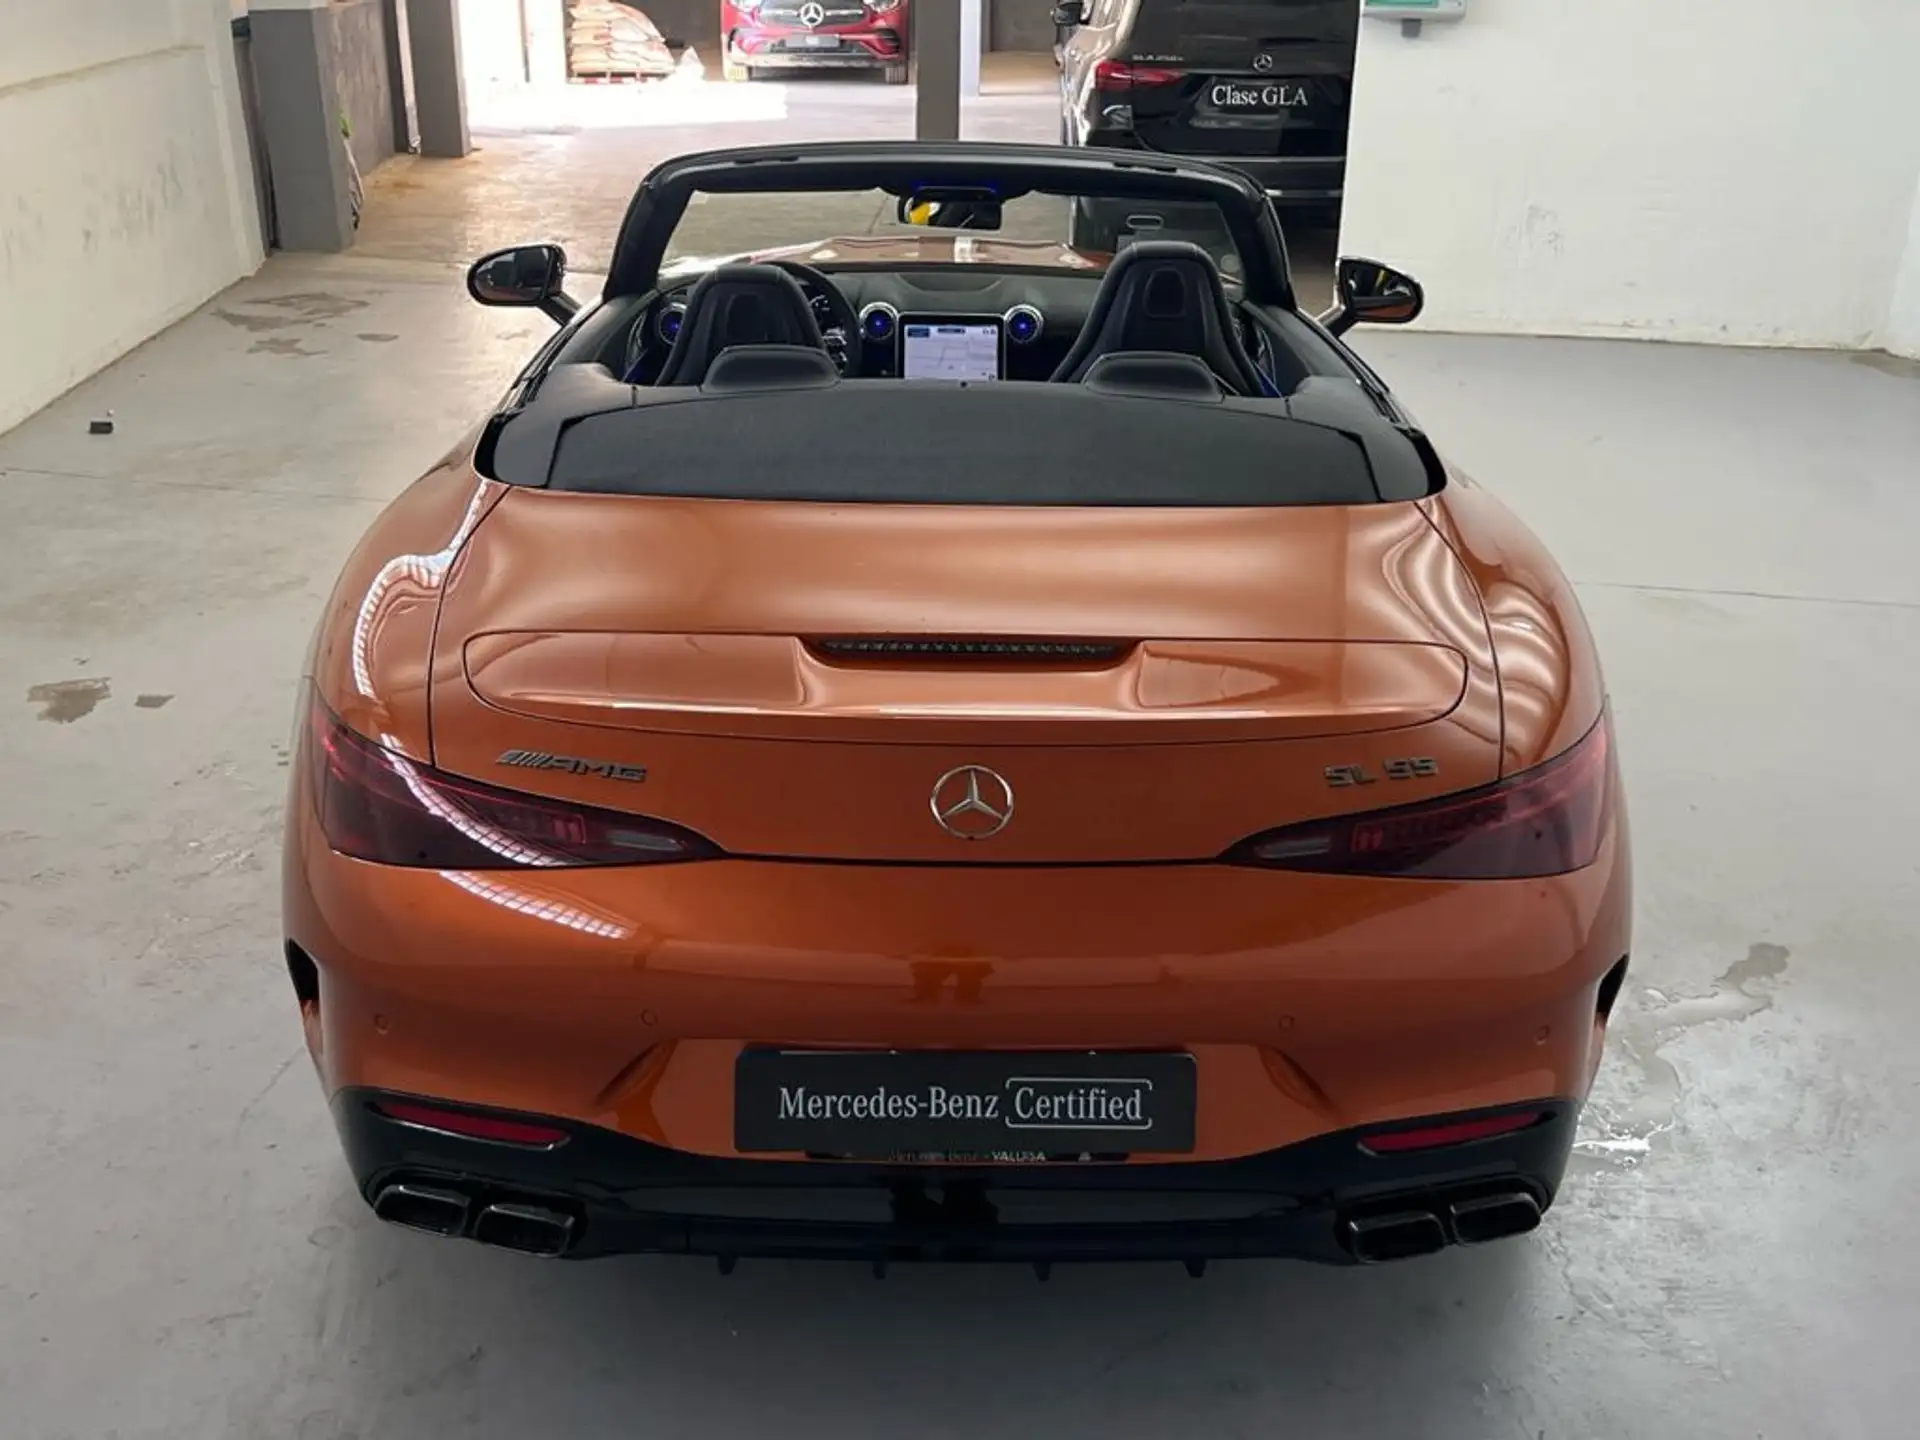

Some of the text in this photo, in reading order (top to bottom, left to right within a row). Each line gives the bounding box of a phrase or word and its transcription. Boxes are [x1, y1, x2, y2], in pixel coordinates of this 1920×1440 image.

[1212, 84, 1309, 107] Clase GLA
[540, 755, 647, 781] AMG
[1324, 765, 1379, 787] SL
[778, 1085, 1143, 1121] Mercedes-Benz Certified
